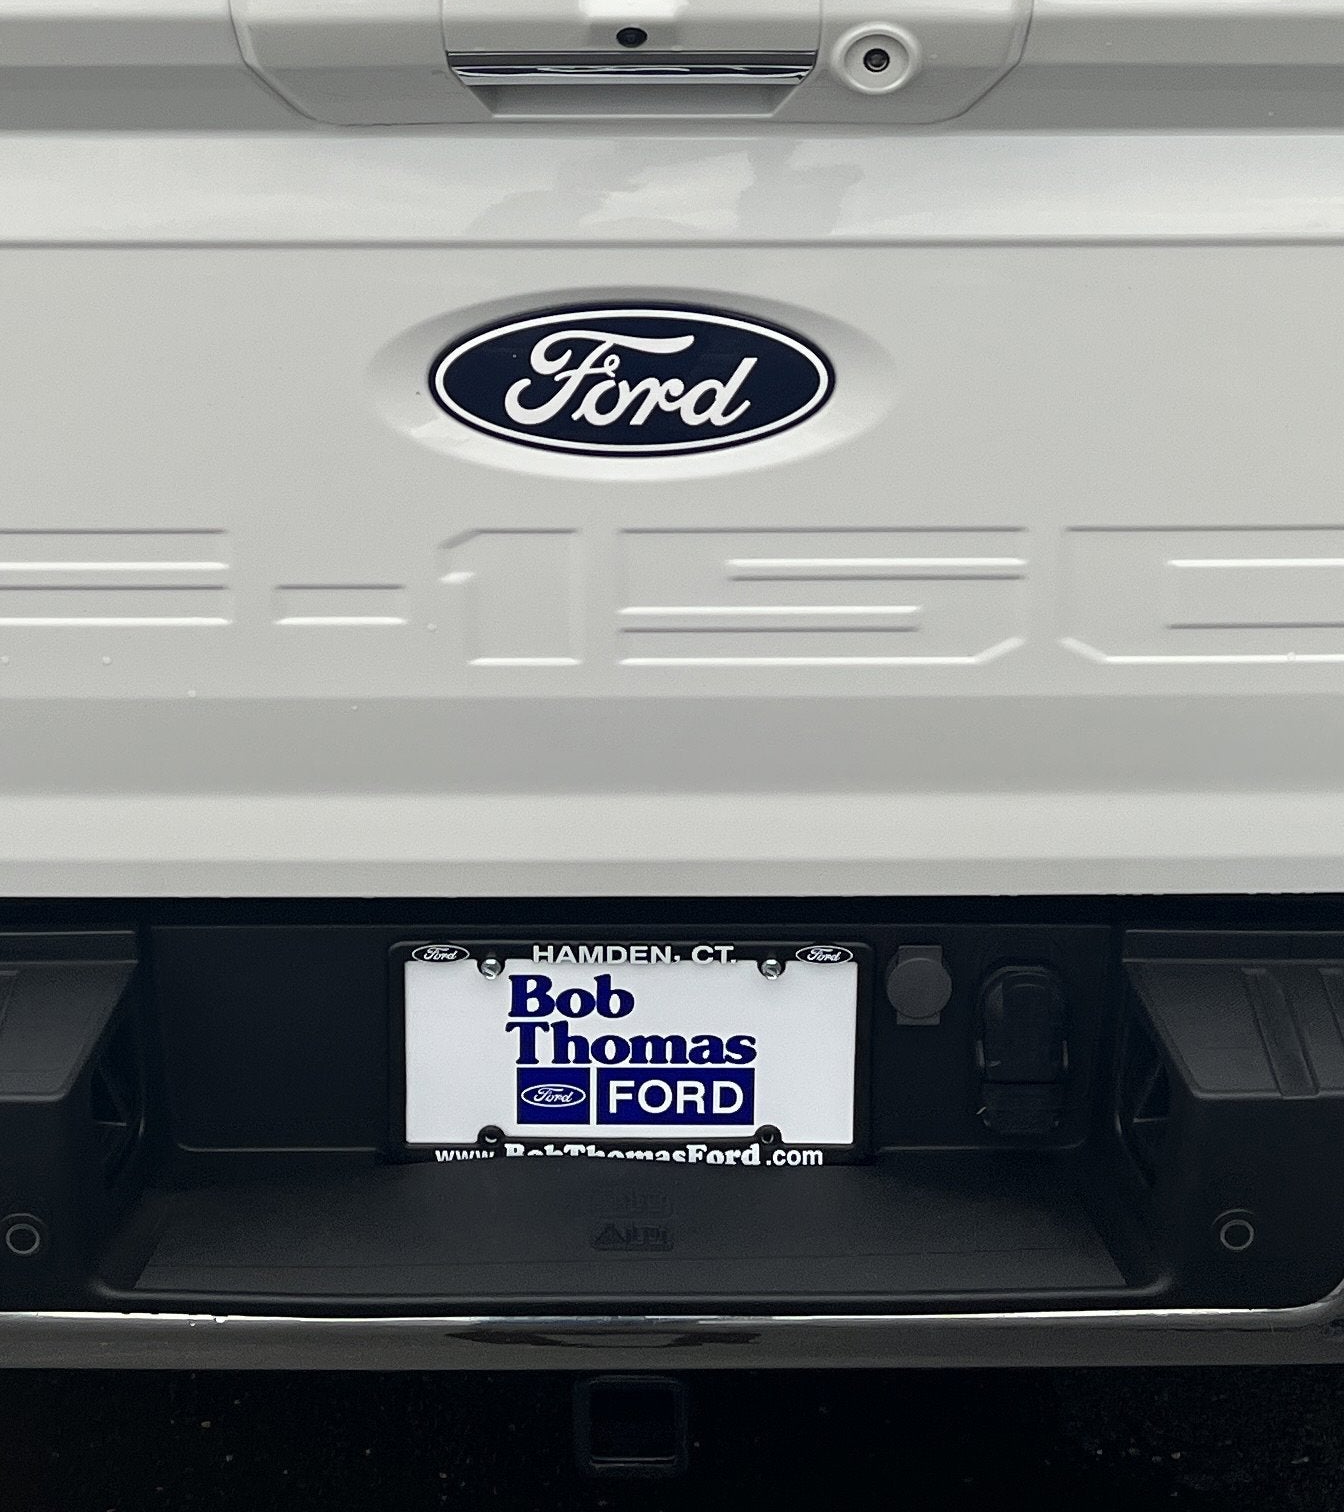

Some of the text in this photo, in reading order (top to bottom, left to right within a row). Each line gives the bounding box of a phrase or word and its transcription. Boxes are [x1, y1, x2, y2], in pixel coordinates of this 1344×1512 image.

[504, 329, 758, 427] Ford
[533, 945, 737, 965] HAMDEN, CT.
[507, 973, 635, 1018] Bob
[505, 1020, 757, 1065] Thomas
[609, 1079, 744, 1114] FORD
